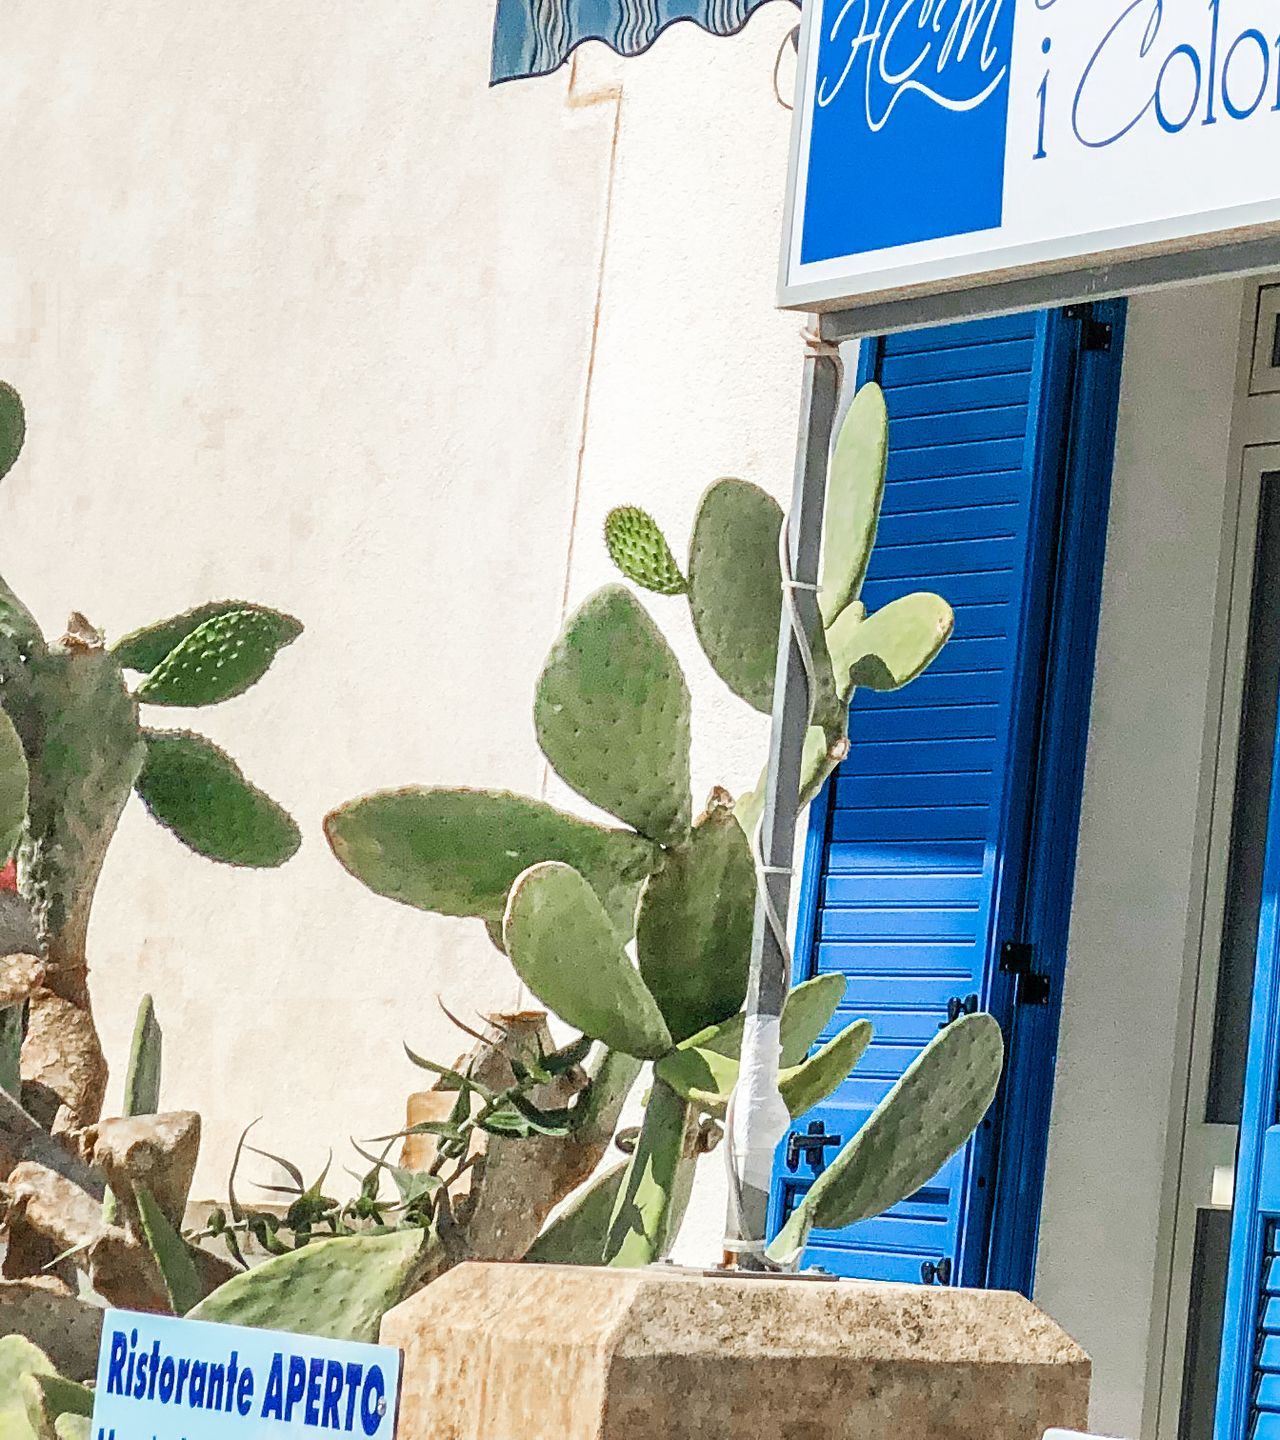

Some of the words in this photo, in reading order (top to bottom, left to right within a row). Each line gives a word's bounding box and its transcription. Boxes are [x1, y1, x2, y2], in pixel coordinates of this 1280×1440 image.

[1033, 36, 1051, 160] i
[106, 1328, 255, 1416] Ristorante
[260, 1352, 386, 1436] APERTO
